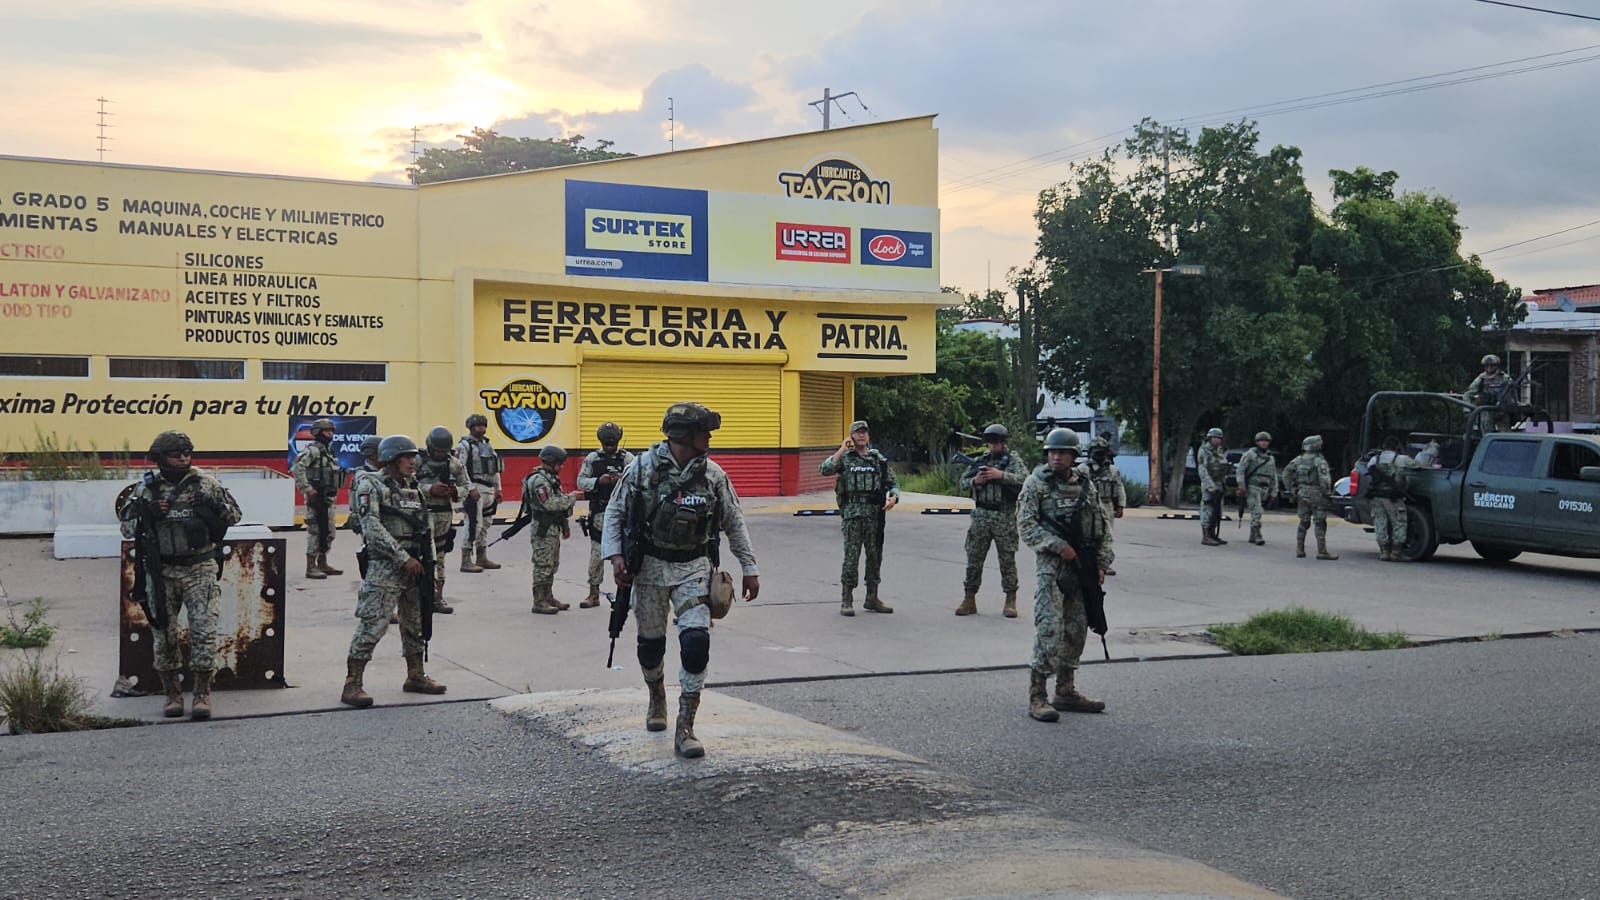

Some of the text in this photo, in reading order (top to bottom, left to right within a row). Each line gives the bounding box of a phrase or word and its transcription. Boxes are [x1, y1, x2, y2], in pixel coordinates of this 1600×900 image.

[817, 166, 861, 180] LUBRICANTES
[779, 172, 890, 205] TAYRON
[12, 192, 87, 210] GRADO
[97, 197, 109, 211] 5
[265, 207, 277, 222] Y
[281, 209, 384, 228] MILIMETRICO
[0, 213, 338, 245] MIENTAS MANUALES Y ELECTRICAS
[592, 217, 685, 238] SURTEK
[648, 240, 686, 249] STORE
[782, 228, 846, 249] URREA
[873, 240, 902, 255] Lock
[185, 252, 264, 269] SILICONES
[575, 259, 613, 267] urrea.com
[185, 271, 317, 290] LINEA HIDRAULICA
[0, 282, 171, 302] LATON Y GALVANIZADO
[185, 290, 320, 308] ACEITES Y FILTROS
[37, 303, 72, 319] TIPO
[185, 309, 384, 329] PINTURAS VINILICAS Y ESMALTES
[504, 299, 788, 332] FERRETERIA Y
[185, 328, 338, 346] PRODUCTOS QUIMICOS
[504, 324, 787, 350] REFACCIONARIA
[821, 323, 908, 350] PATRIA.
[0, 392, 375, 421] xima Protección para tu Motor!
[480, 390, 566, 410] TAYRON
[340, 443, 361, 452] AQU
[1474, 492, 1515, 503] EJÉRCITO
[1474, 501, 1514, 509] MEXICANO
[1559, 500, 1593, 512] 0915306
